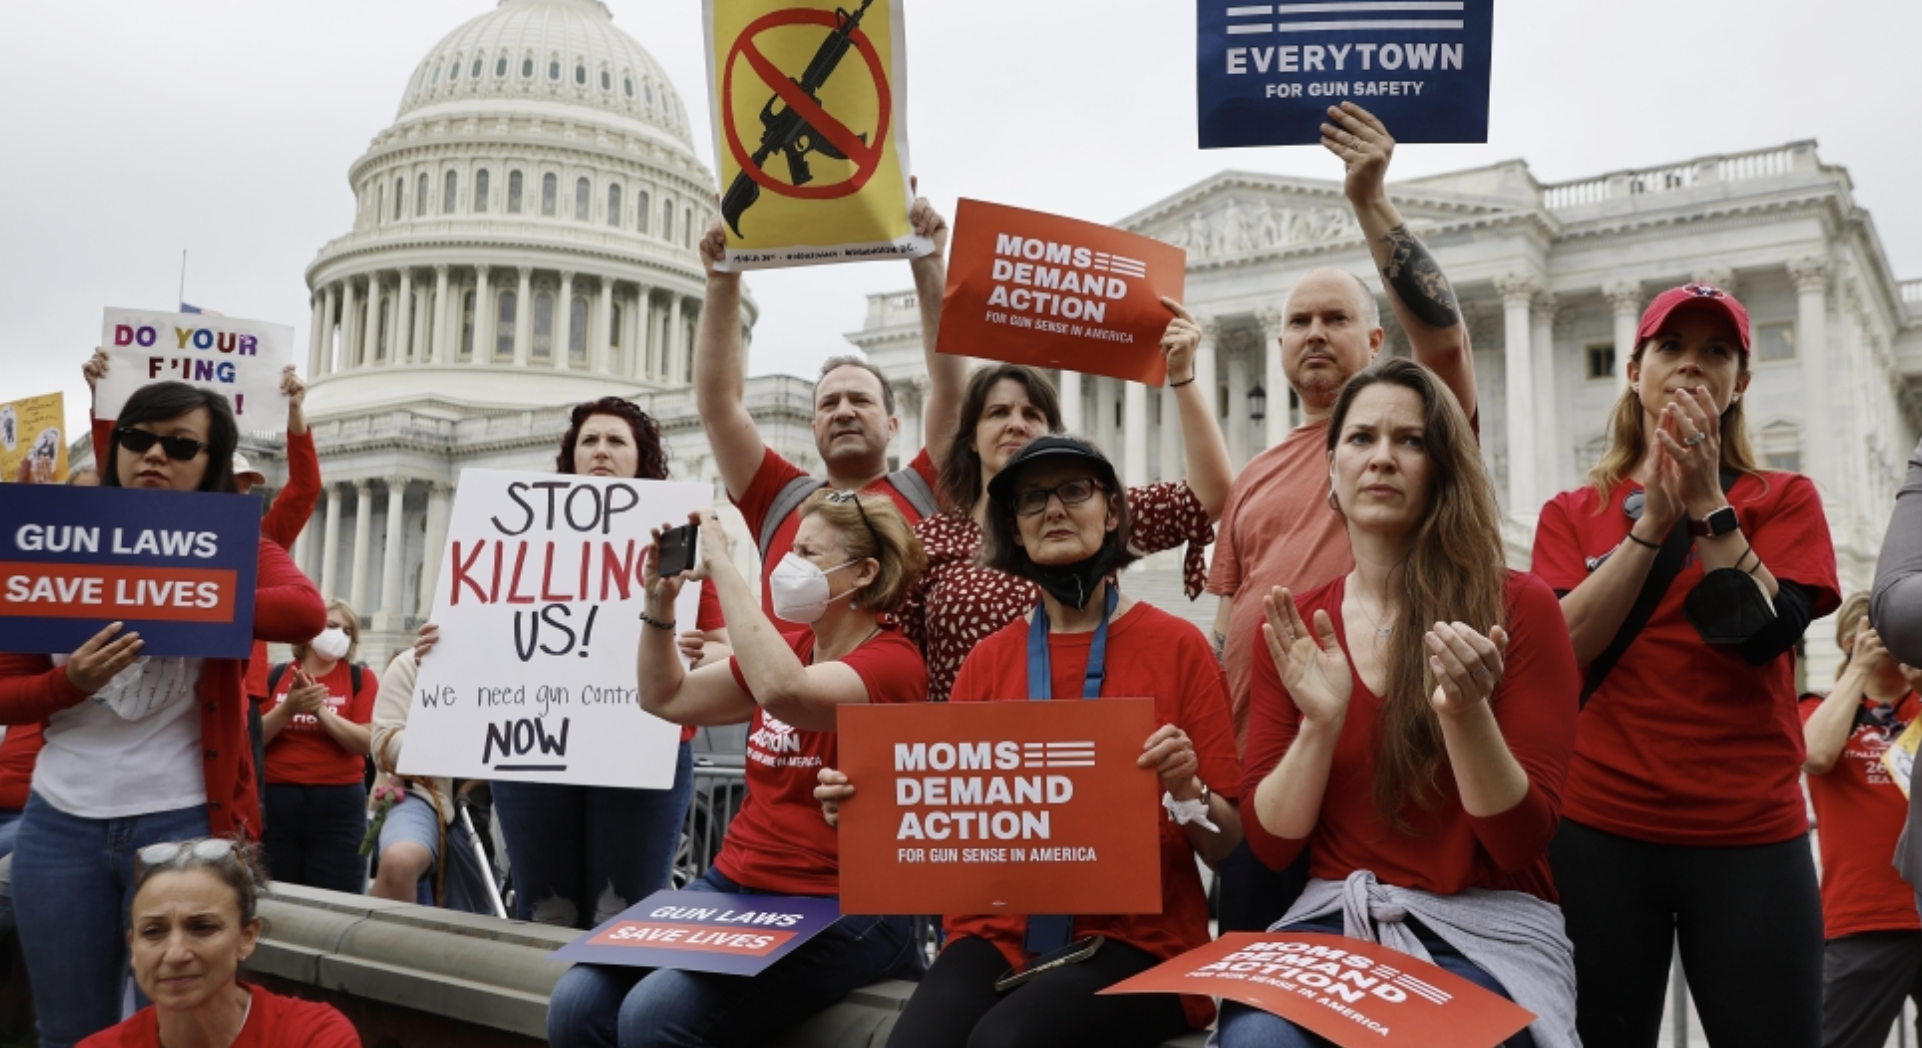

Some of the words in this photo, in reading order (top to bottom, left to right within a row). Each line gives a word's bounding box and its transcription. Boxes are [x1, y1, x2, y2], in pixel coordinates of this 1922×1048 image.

[1226, 43, 1464, 74] EVERYTOWN
[1265, 84, 1302, 98] FOR
[1308, 82, 1348, 96] GUN
[1353, 81, 1424, 96] SAFETY
[995, 233, 1092, 268] MOMS
[992, 259, 1128, 299] DEMAND
[987, 286, 1106, 323] ACTION
[115, 324, 156, 347] DO
[174, 327, 258, 356] YOUR
[985, 310, 1006, 325] FOR
[1010, 315, 1032, 328] GUN
[1035, 319, 1069, 334] SENSE
[1071, 325, 1083, 337] IN
[1085, 327, 1134, 343] AMERICA
[149, 356, 236, 383] F'ING
[490, 481, 639, 536] STOP
[16, 524, 99, 552] GUN
[112, 528, 218, 558] LAWS
[5, 575, 104, 604] SAVE
[115, 579, 219, 608] LIVES
[513, 603, 599, 662] US!
[477, 685, 526, 708] need
[535, 685, 569, 718] gun
[482, 716, 570, 764] NOW
[894, 741, 1020, 772] MOMS
[896, 775, 1074, 805] DEMAND
[897, 810, 1050, 840] ACTION
[898, 848, 925, 863] FOR
[929, 847, 958, 862] GUN
[962, 847, 1007, 862] SENSE
[1010, 847, 1025, 862] IN
[1030, 846, 1097, 862] AMERICA
[650, 905, 718, 921] GUN
[714, 909, 804, 927] LAWS
[608, 925, 690, 944] SAVE
[684, 929, 775, 949] LIVES
[1242, 942, 1374, 969] MOMS
[1198, 962, 1366, 1003] ACTION
[1220, 951, 1407, 1003] DEMAND
[1216, 972, 1249, 980] GUN
[1248, 974, 1299, 992] SENSE
[1297, 987, 1317, 999] IN
[1316, 996, 1390, 1038] AMERICA
